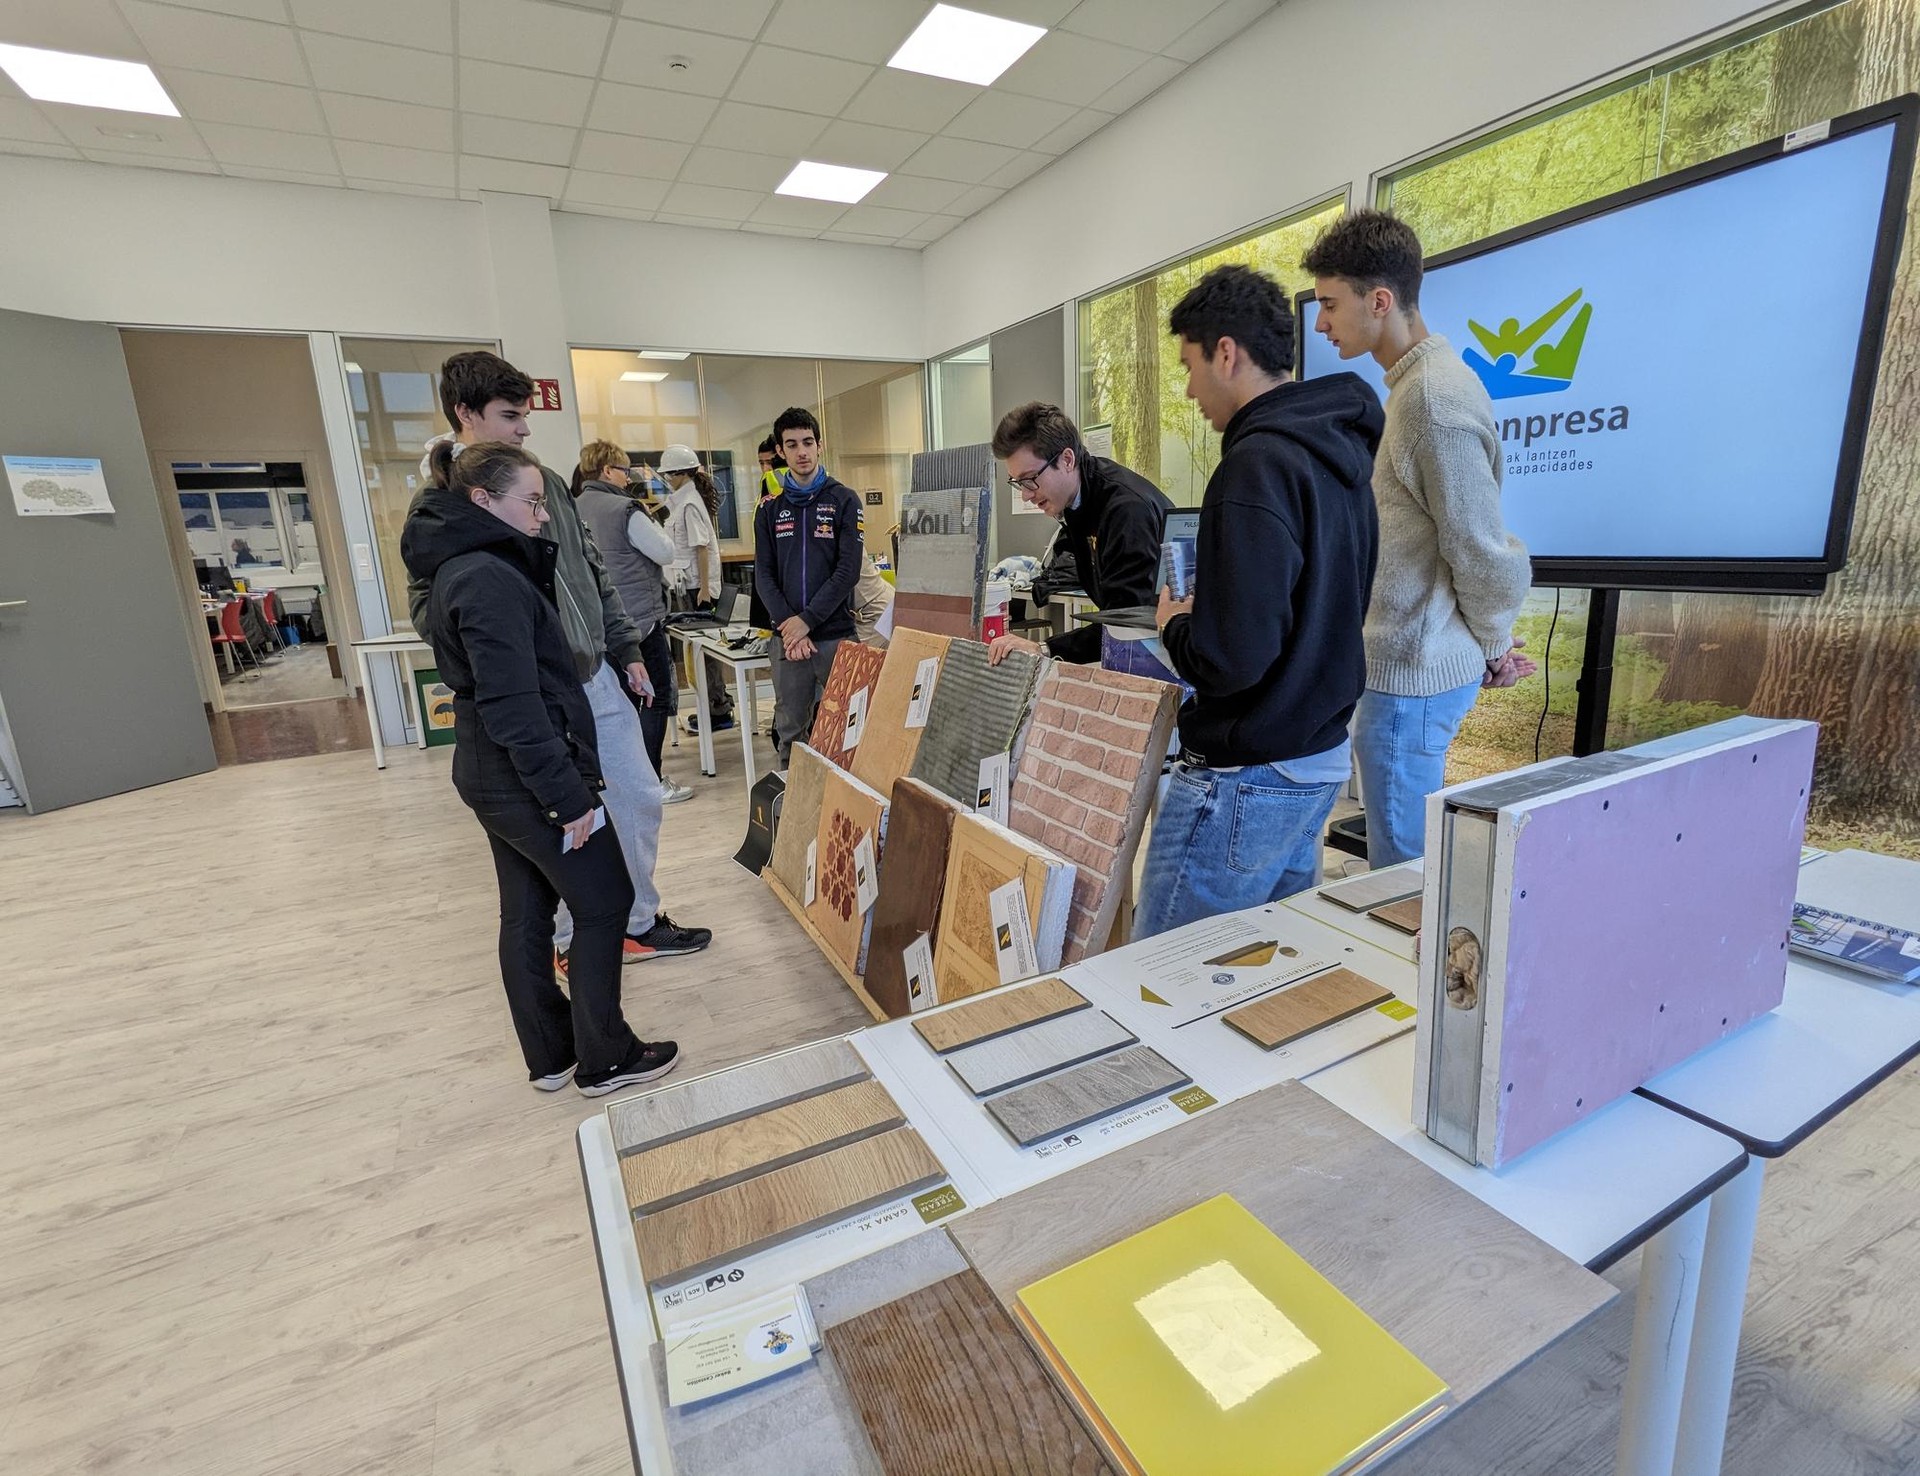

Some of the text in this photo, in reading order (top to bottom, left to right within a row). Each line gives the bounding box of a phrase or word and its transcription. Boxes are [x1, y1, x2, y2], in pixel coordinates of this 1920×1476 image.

[1495, 405, 1629, 448] npresa
[1506, 449, 1576, 463] ak lantzen
[1508, 460, 1593, 476] capacidades
[1144, 1104, 1170, 1117] GAMA
[920, 1194, 957, 1213] STREAM
[857, 1208, 909, 1232] GAMA XL
